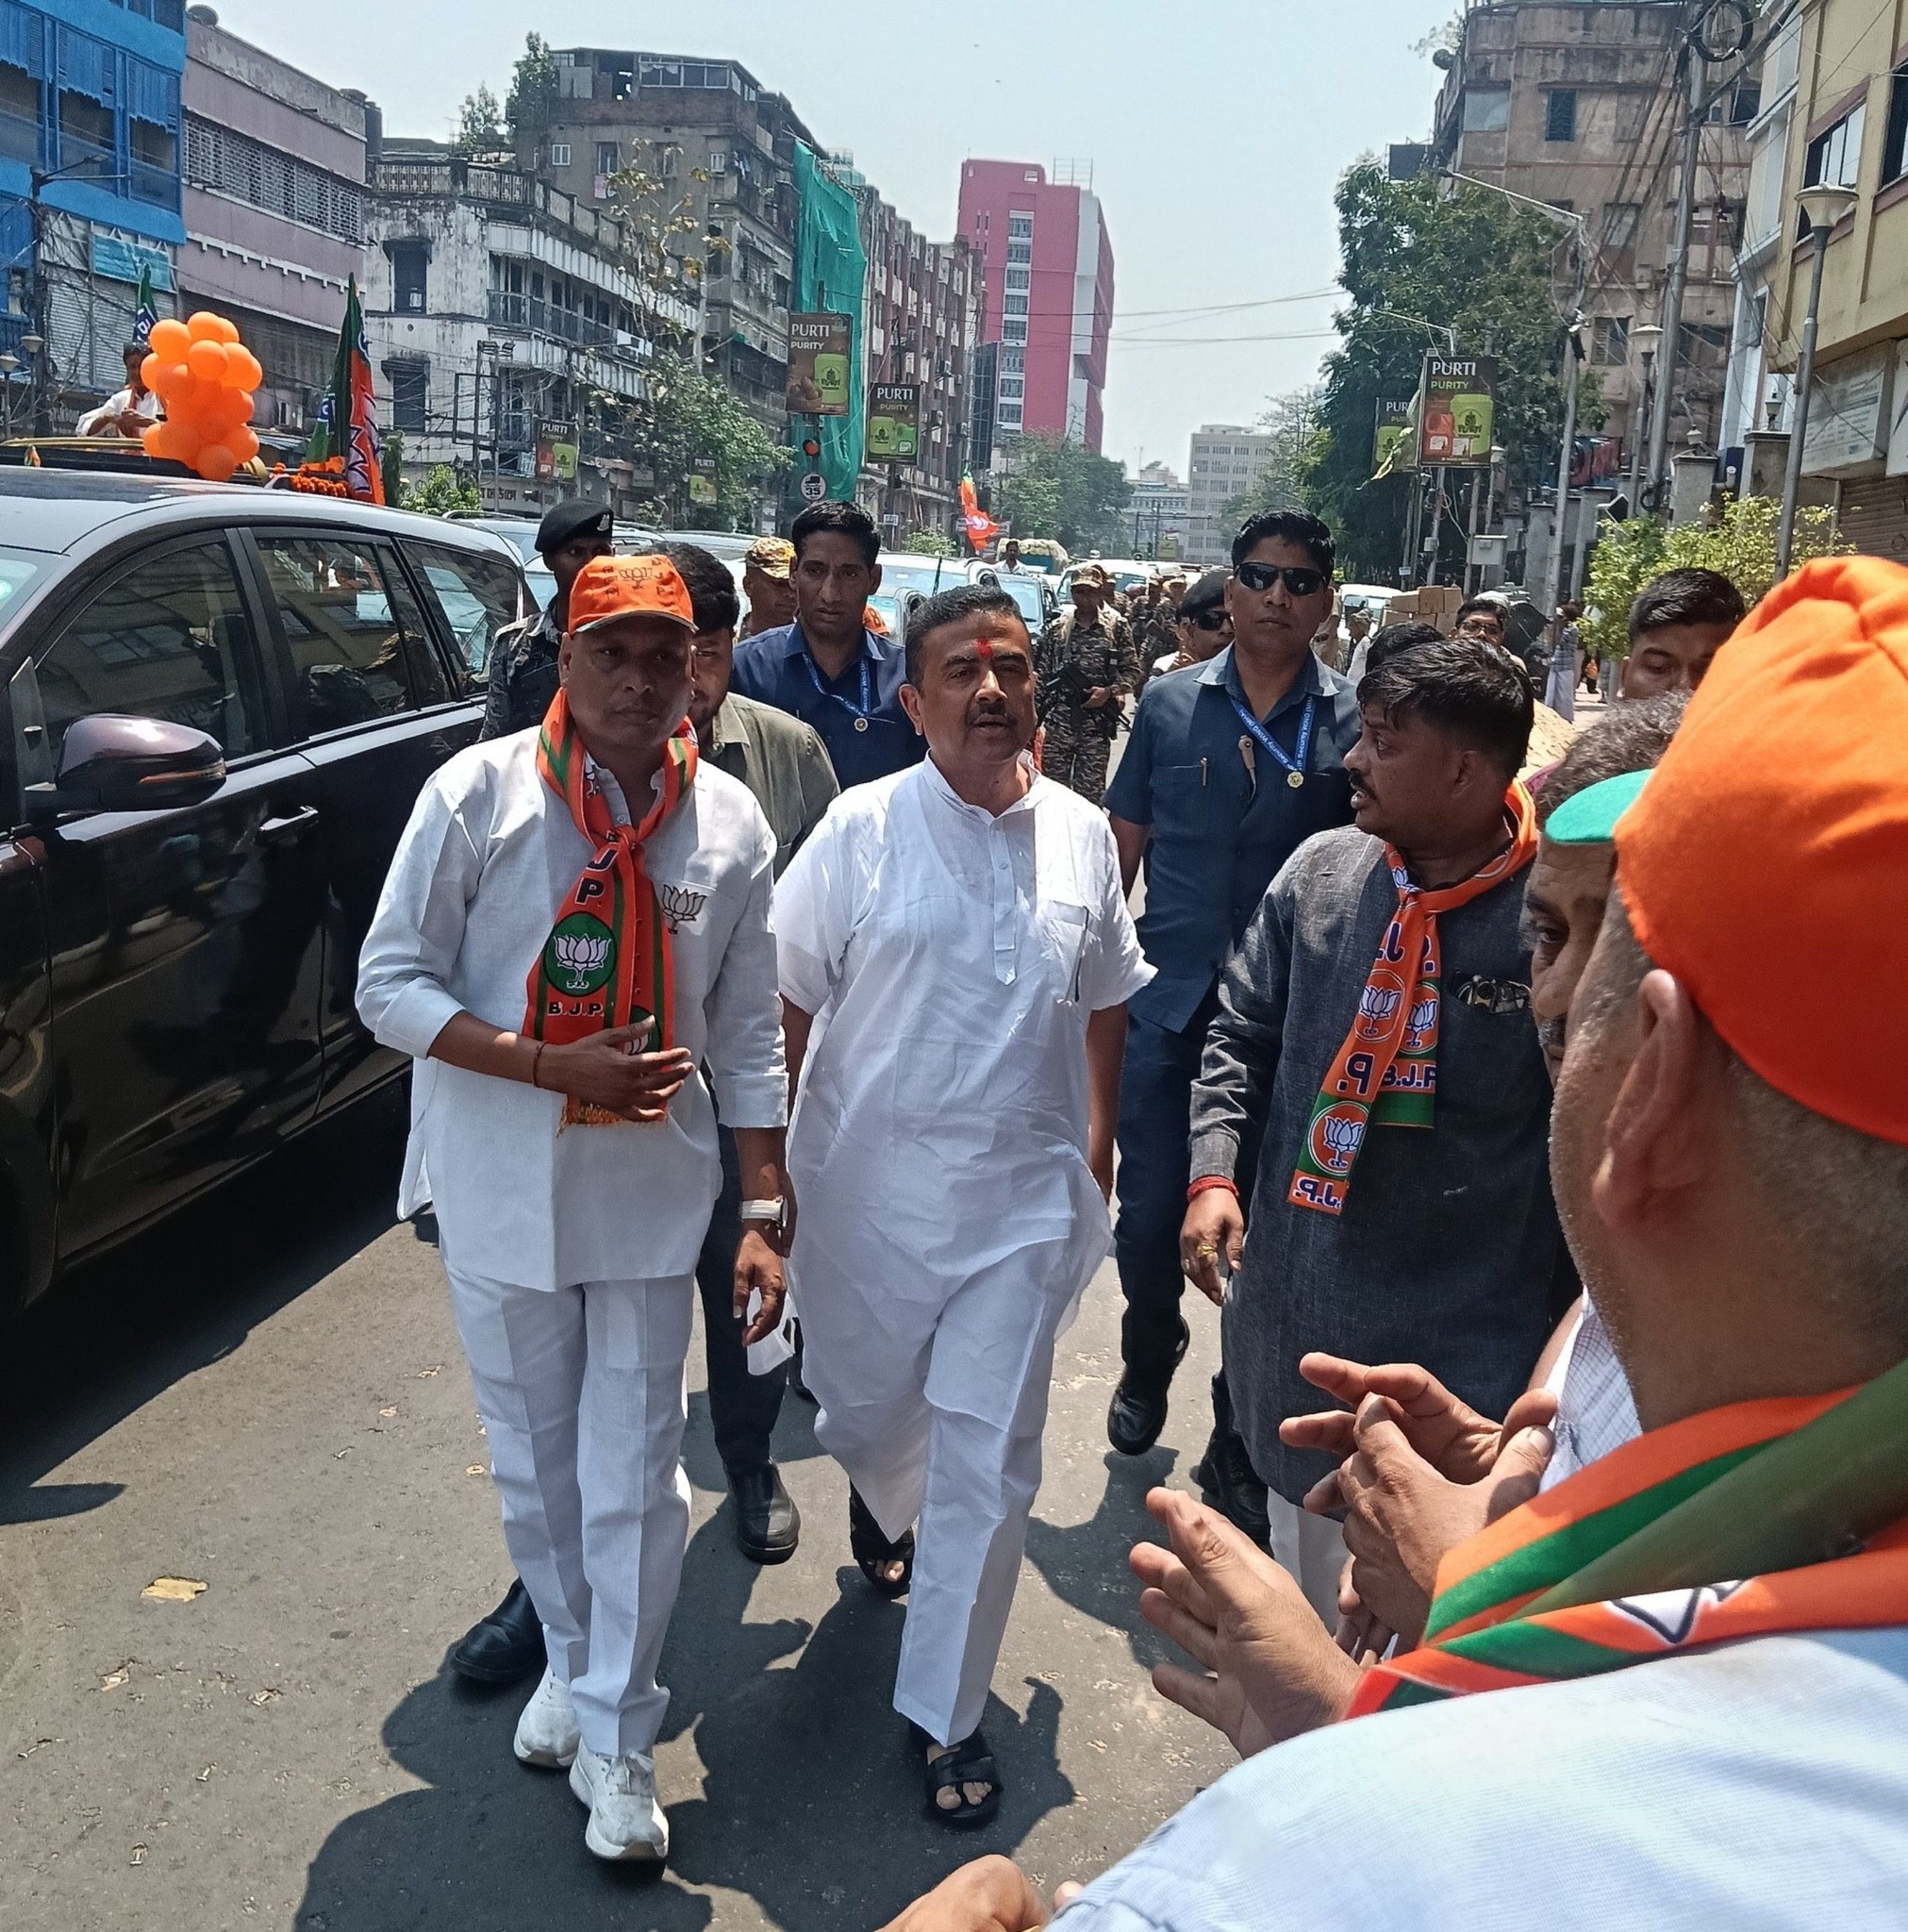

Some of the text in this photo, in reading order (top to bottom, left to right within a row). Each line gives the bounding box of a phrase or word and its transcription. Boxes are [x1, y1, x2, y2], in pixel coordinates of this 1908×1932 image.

[791, 324, 829, 337] PURTI
[790, 341, 824, 350] PURITY
[1433, 361, 1476, 376] PURTI
[1431, 380, 1468, 390] PURITY
[877, 388, 913, 400] PURTI
[880, 403, 908, 411] PURITY
[1386, 401, 1408, 412] PUR
[542, 423, 568, 434] PURTI
[805, 487, 821, 495] 35
[1253, 725, 1269, 743] WING
[1298, 732, 1308, 758] Security
[1268, 741, 1288, 764] Security
[547, 1001, 605, 1017] B.J.P.
